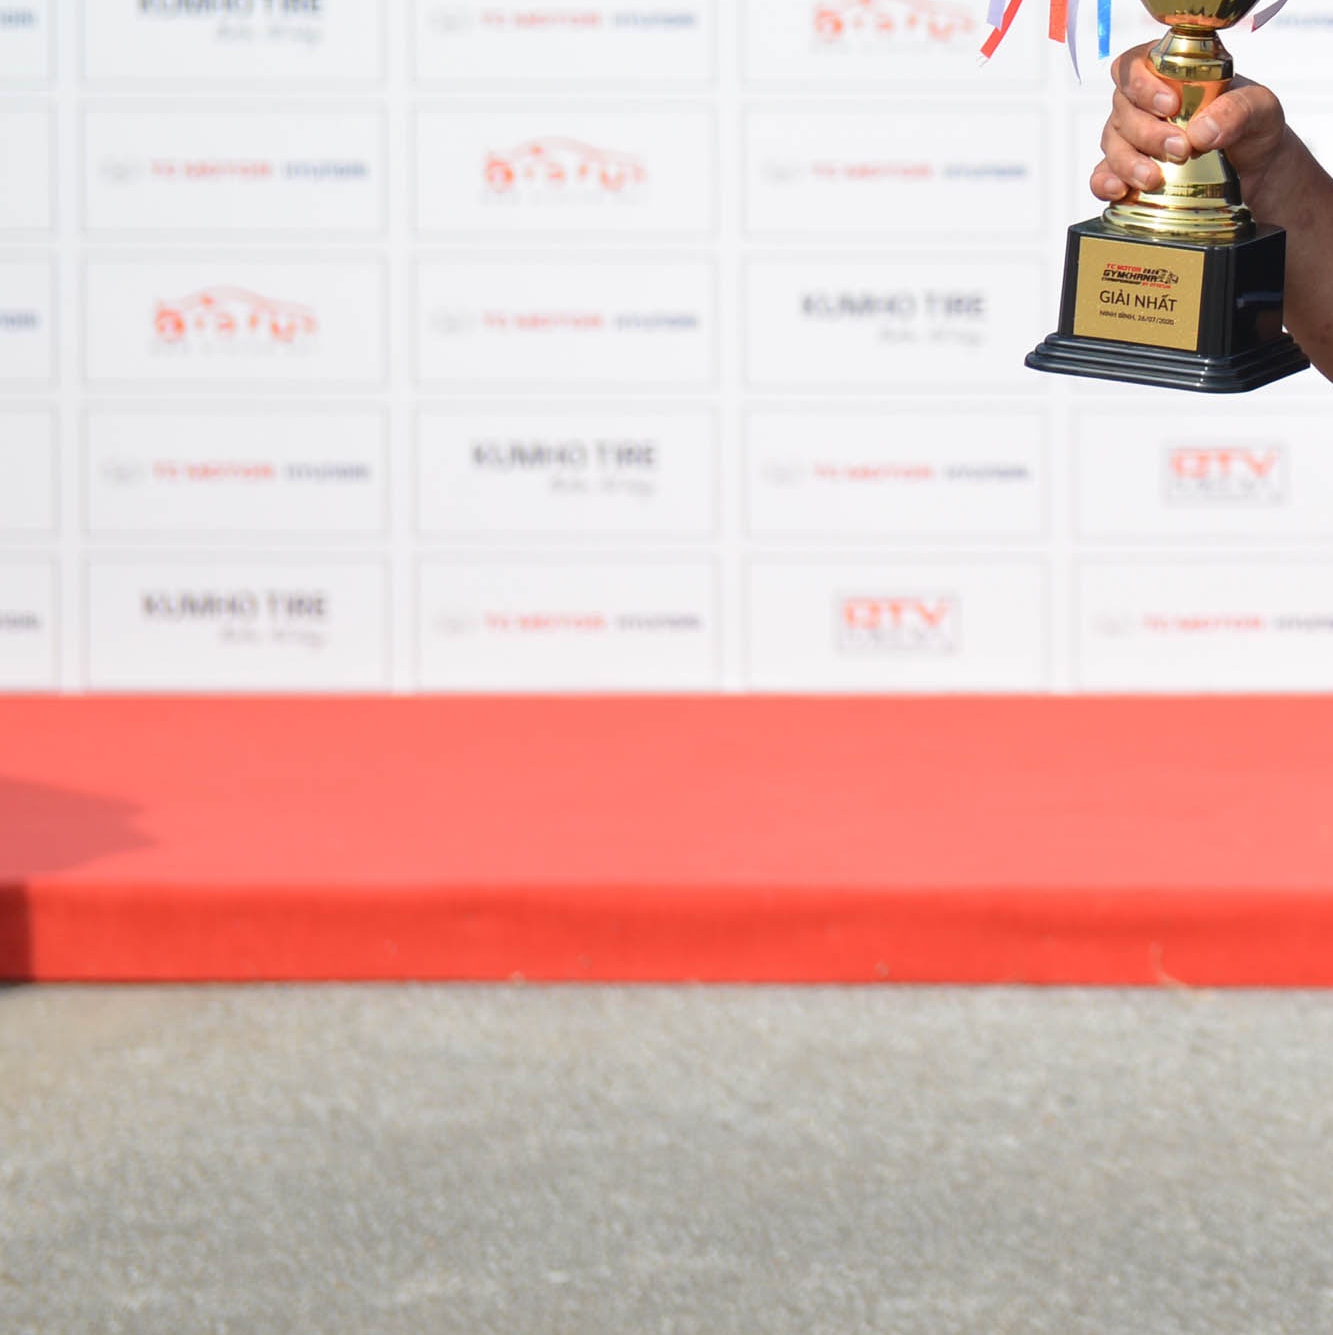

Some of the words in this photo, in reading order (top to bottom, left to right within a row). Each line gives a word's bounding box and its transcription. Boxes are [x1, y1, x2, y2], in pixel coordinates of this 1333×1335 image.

[1103, 269, 1158, 282] GYMKHANA
[1100, 289, 1130, 306] GIẢI
[1135, 294, 1177, 312] NHẤT
